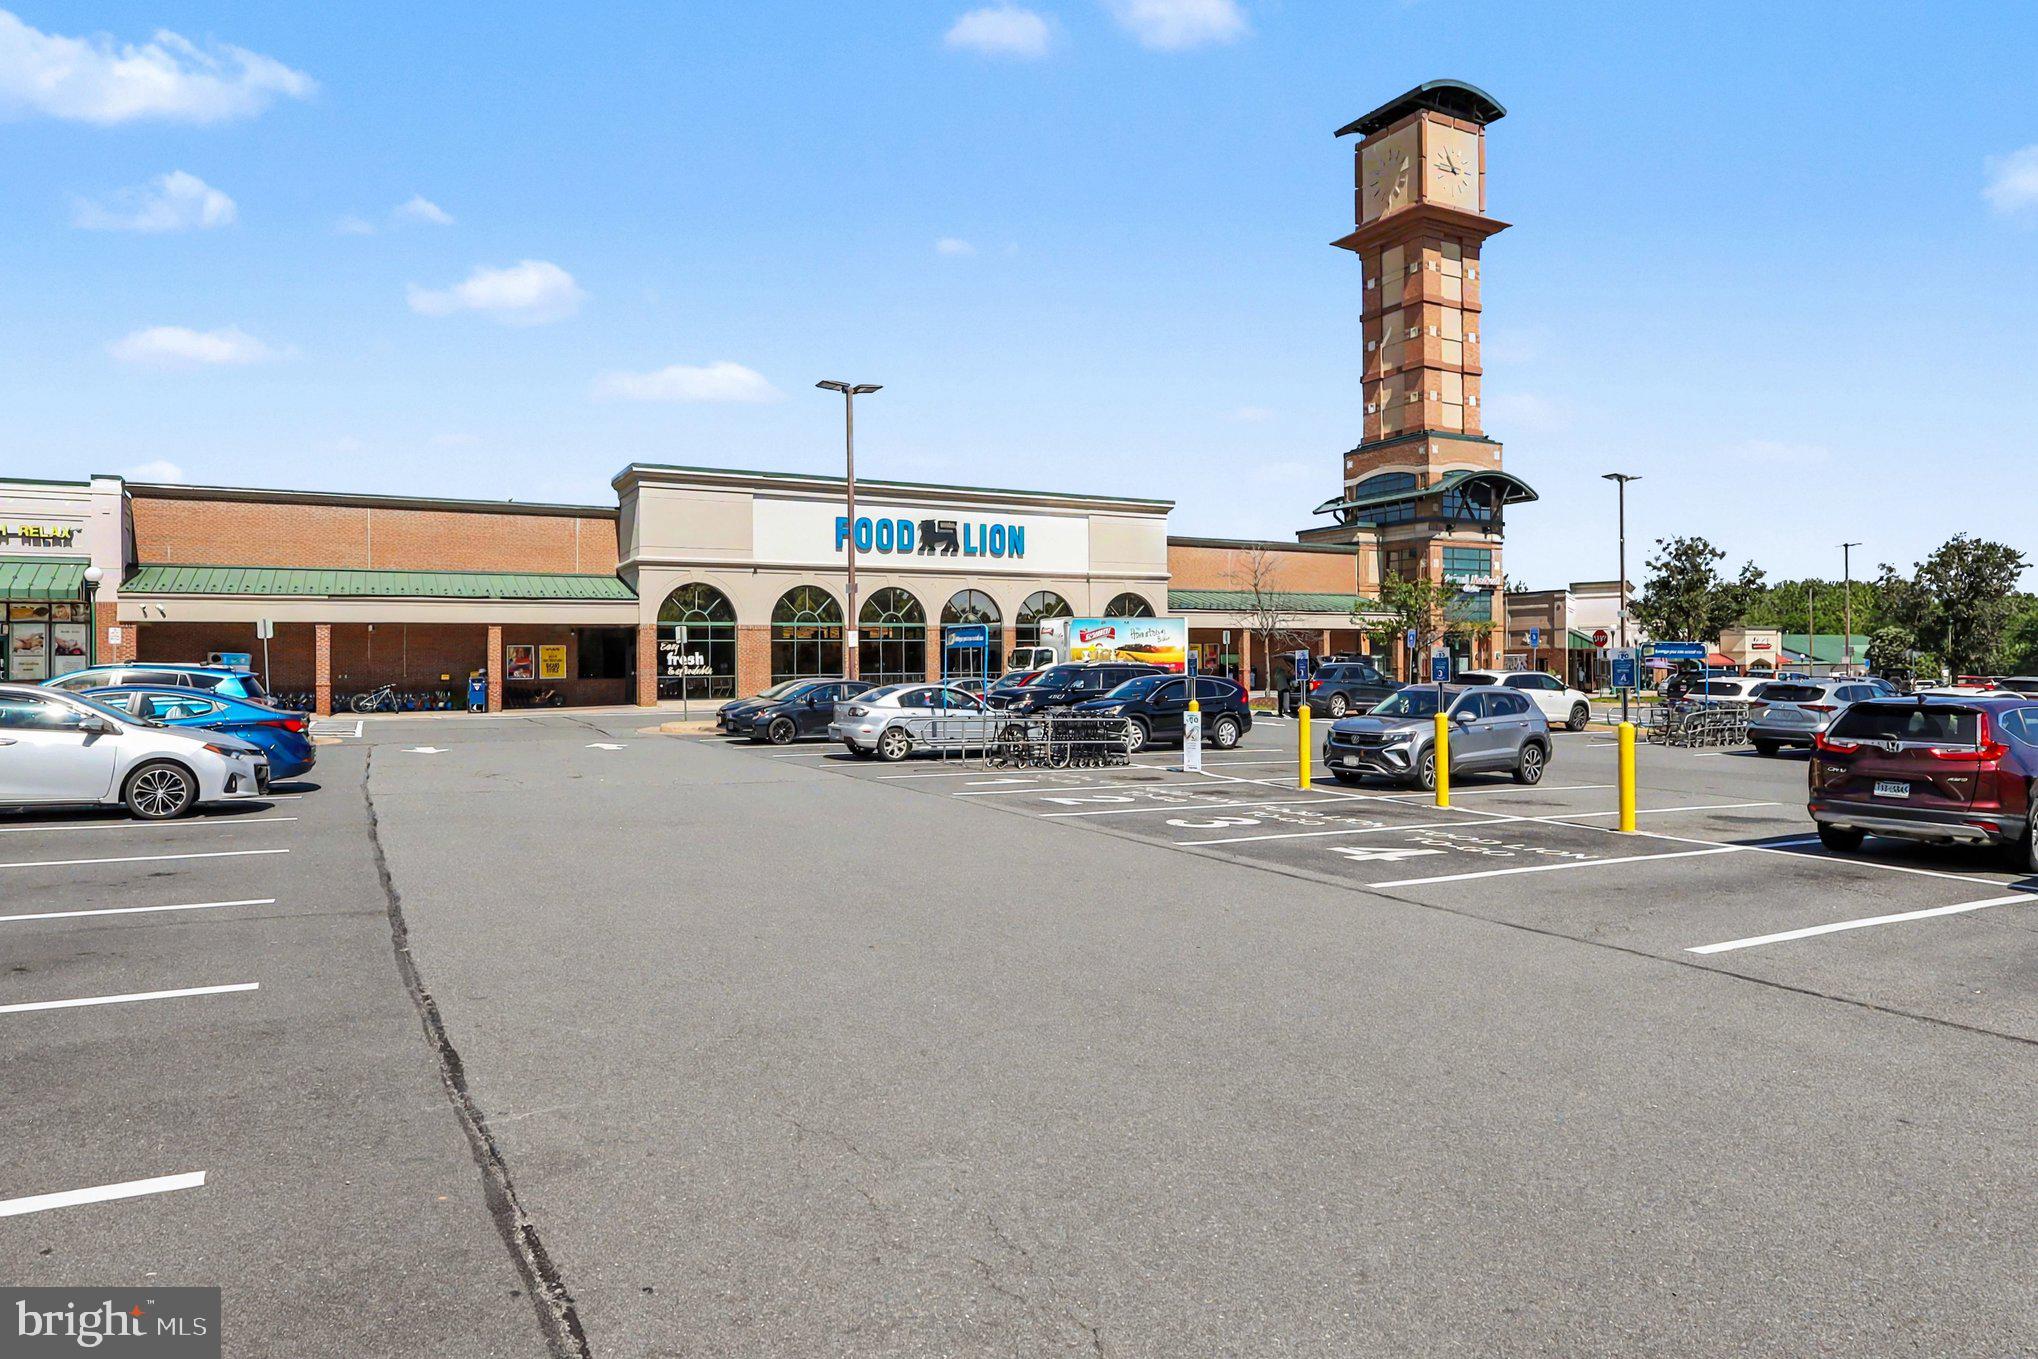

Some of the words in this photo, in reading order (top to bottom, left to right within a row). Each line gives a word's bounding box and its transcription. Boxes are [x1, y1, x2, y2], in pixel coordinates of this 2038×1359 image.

[18, 524, 71, 538] RELAX
[835, 516, 915, 551] FOOD
[963, 522, 1025, 556] LION
[660, 642, 680, 655] Easy
[666, 651, 704, 666] fresh
[1039, 795, 1136, 806] 2
[1165, 816, 1262, 828] 3
[1326, 846, 1449, 862] 4
